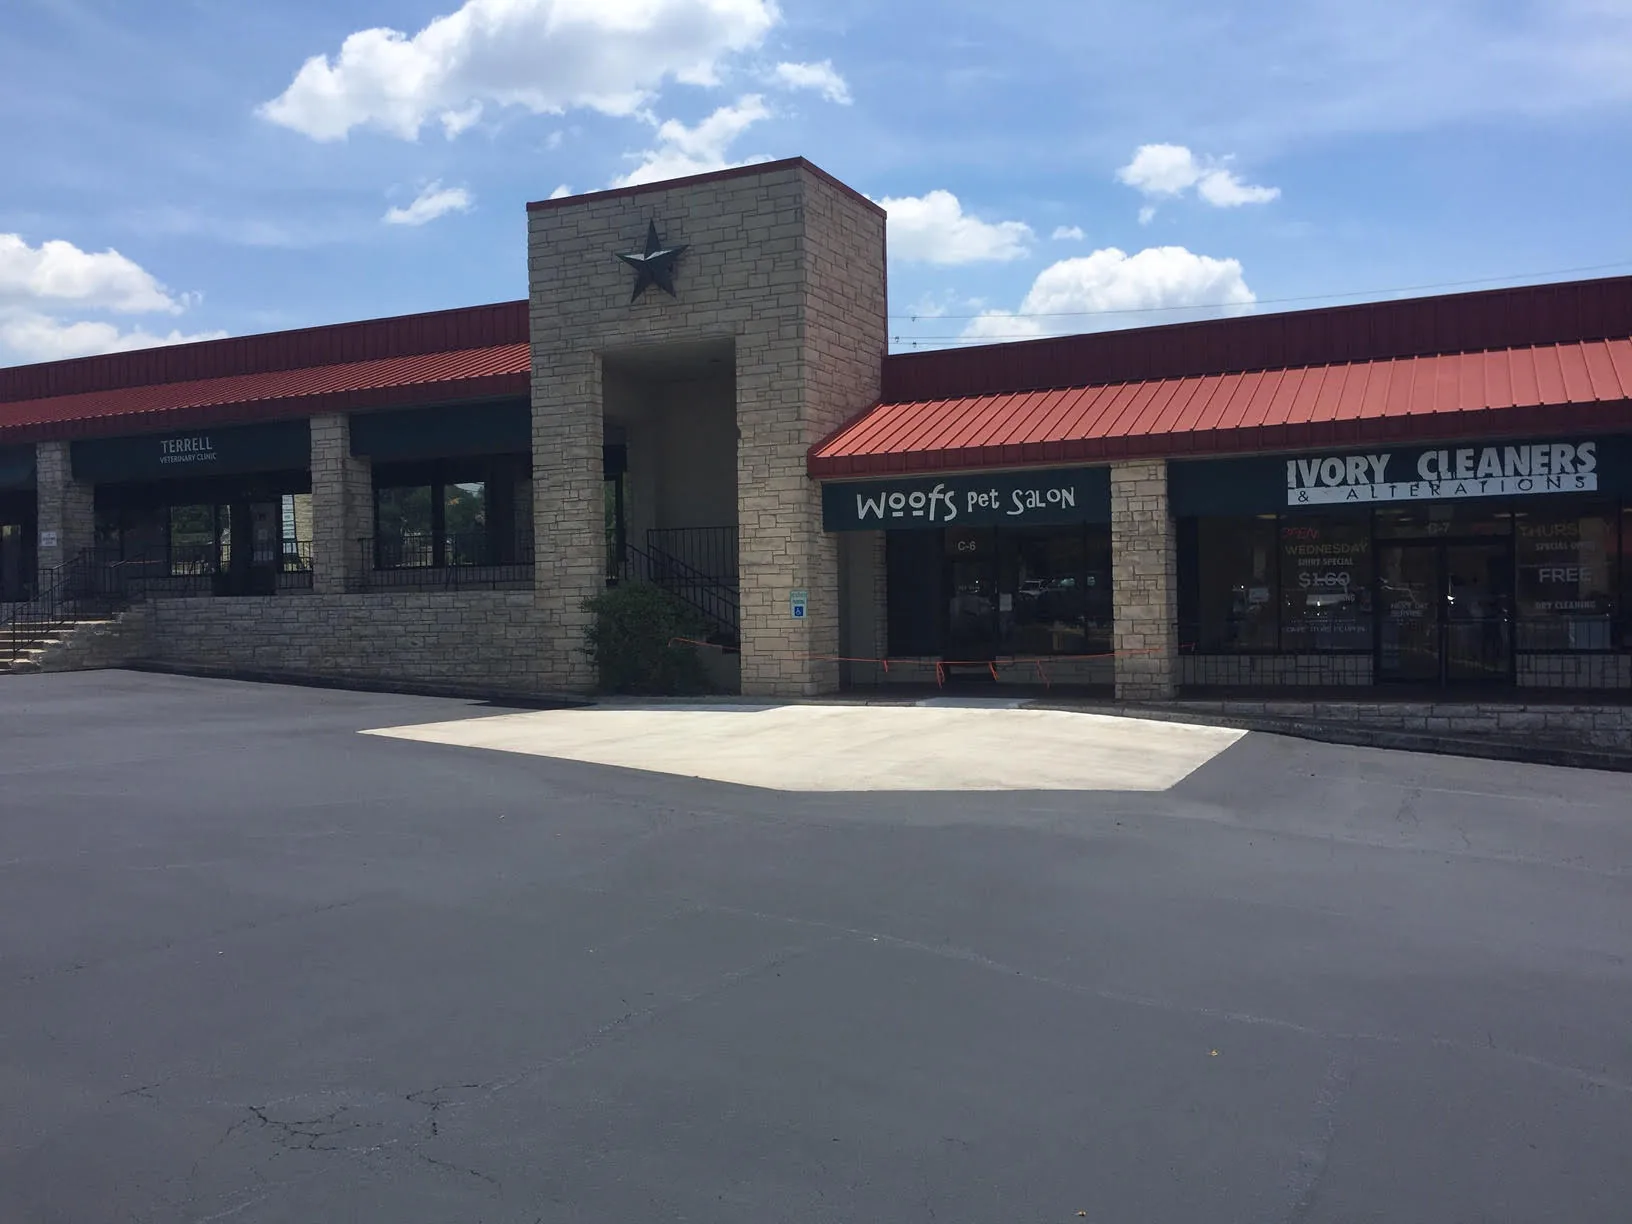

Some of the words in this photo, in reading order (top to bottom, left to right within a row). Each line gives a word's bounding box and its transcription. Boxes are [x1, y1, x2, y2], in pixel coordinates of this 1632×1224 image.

[160, 437, 213, 454] TERRELL
[160, 454, 195, 464] VETERINARY
[197, 452, 217, 462] CLINIC
[1286, 455, 1391, 488] IVORY
[1417, 442, 1597, 481] CLEANERS
[1298, 491, 1309, 503] &
[1346, 476, 1586, 500] ALTERATIONS
[857, 483, 957, 521] Woofs
[957, 541, 976, 551] C-6
[1285, 542, 1368, 555] WEDNESDAY
[1322, 557, 1353, 566] SPECIAL
[1538, 567, 1592, 583] FREE
